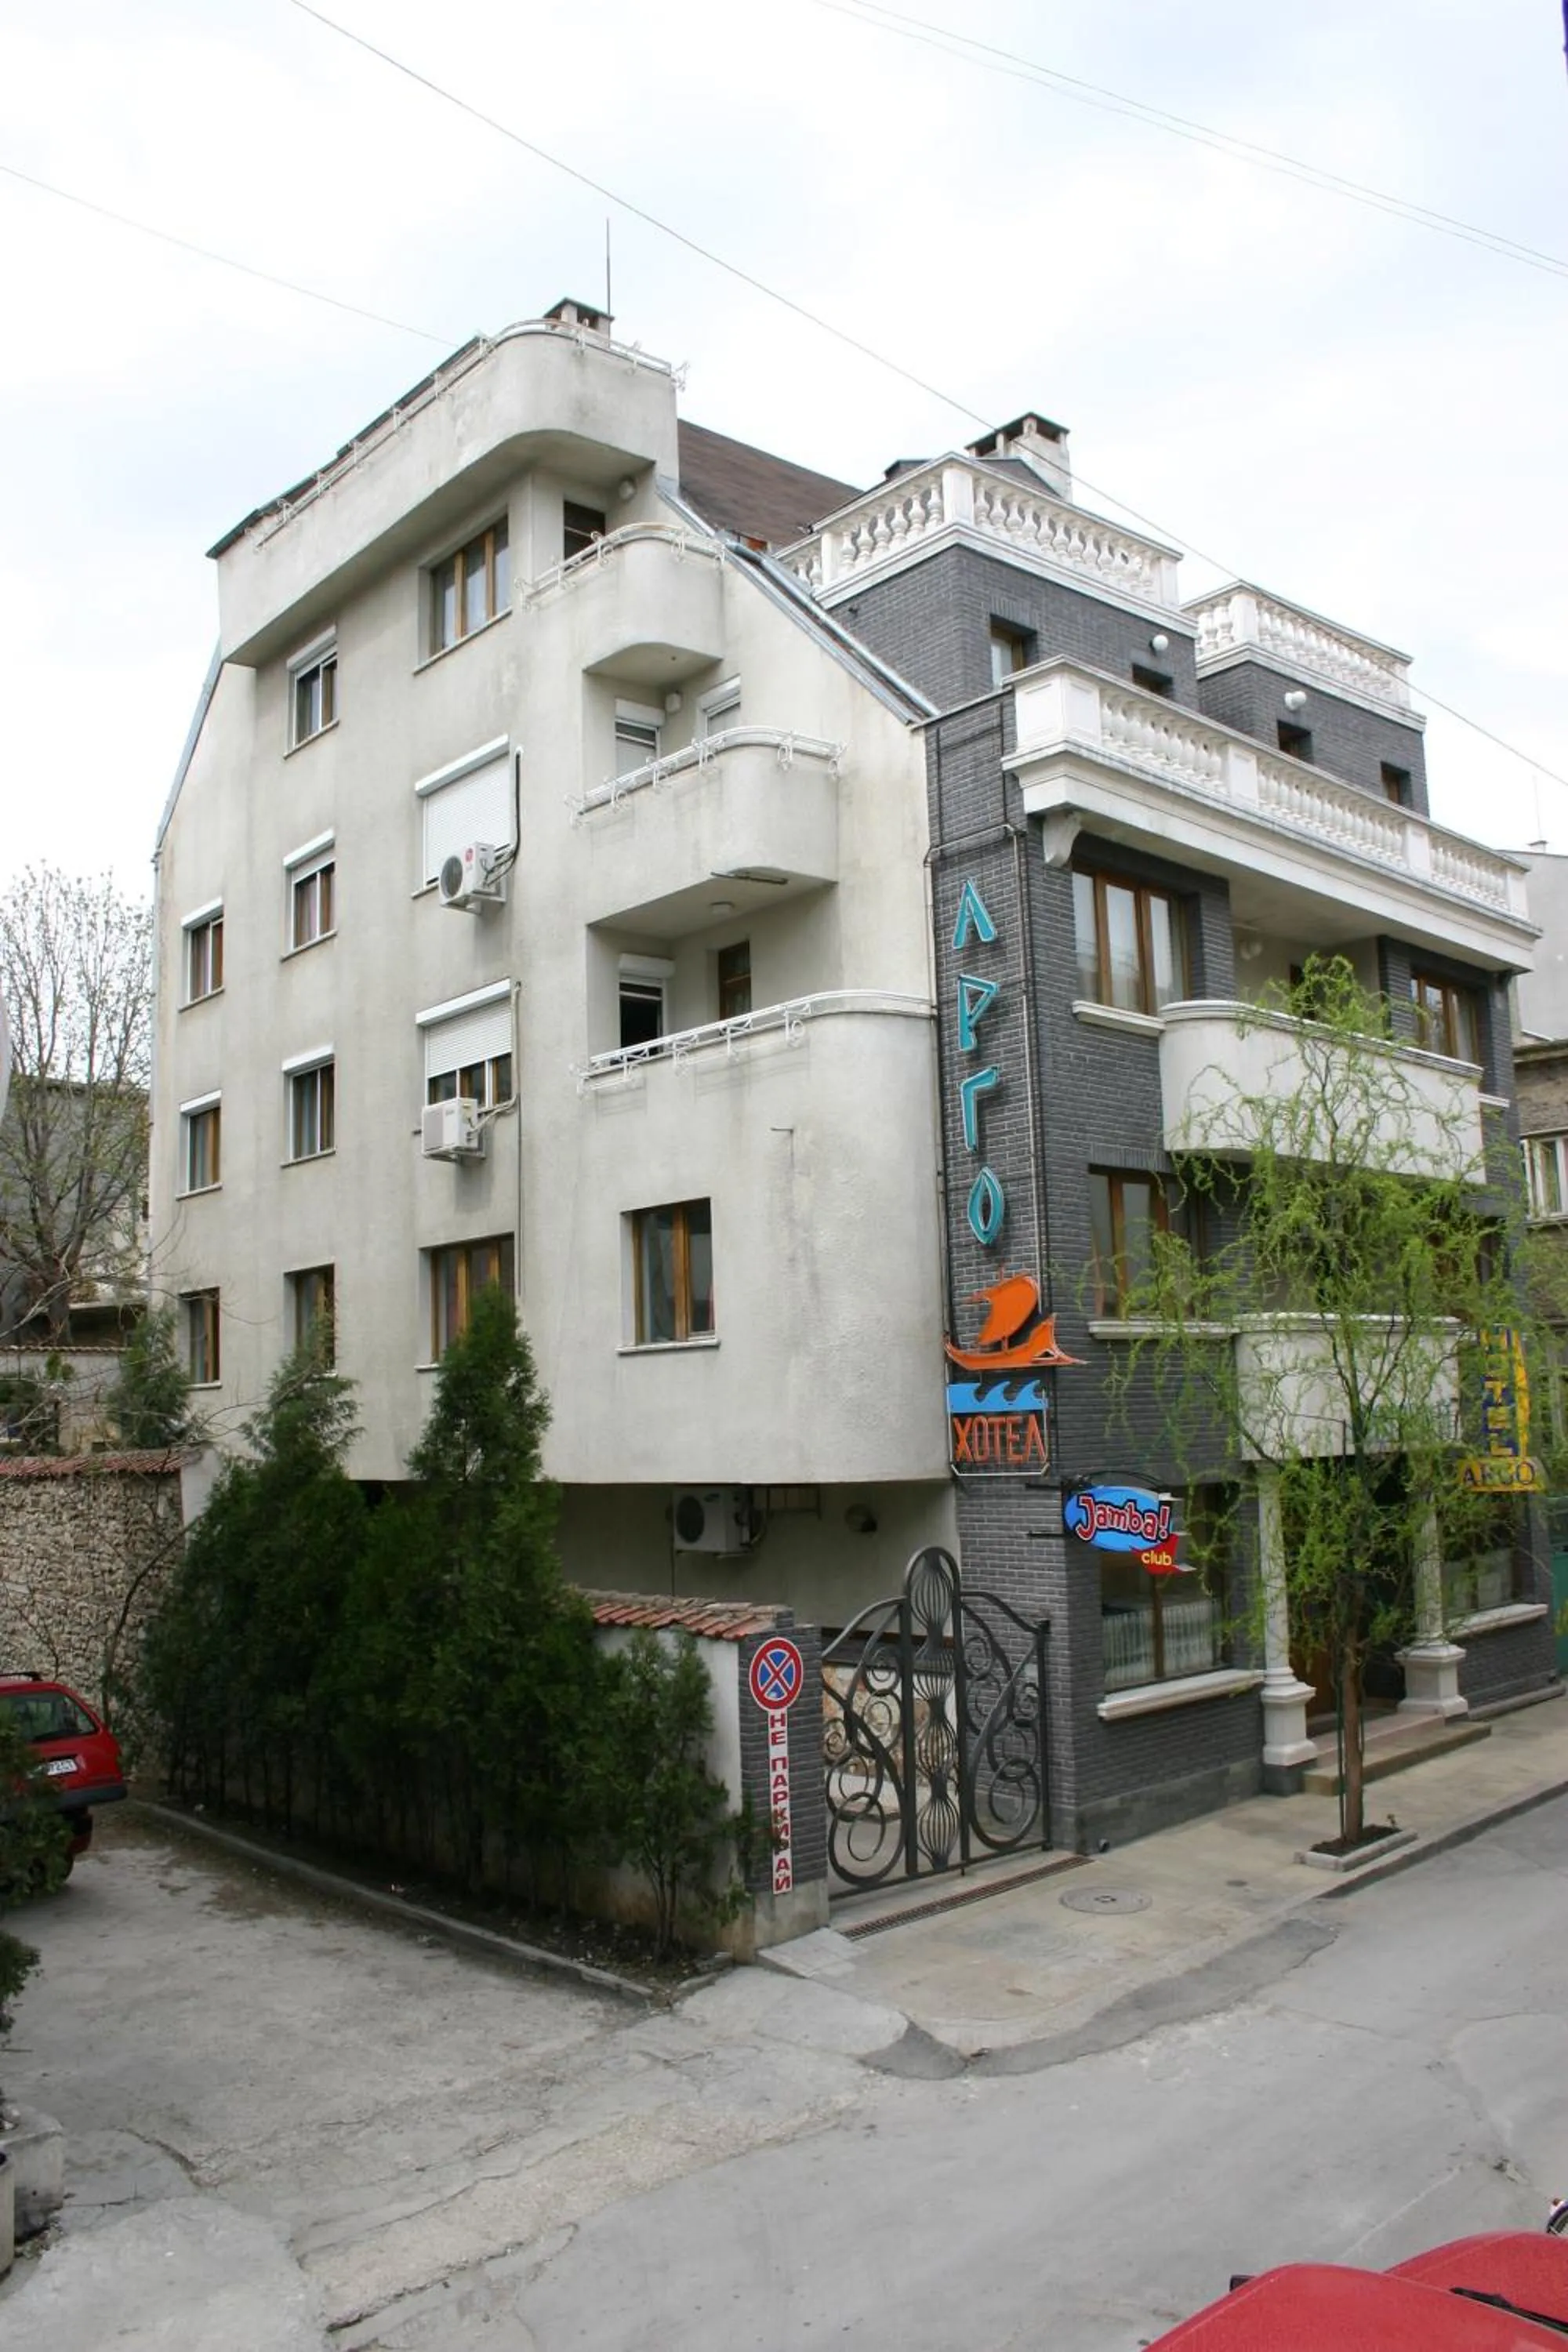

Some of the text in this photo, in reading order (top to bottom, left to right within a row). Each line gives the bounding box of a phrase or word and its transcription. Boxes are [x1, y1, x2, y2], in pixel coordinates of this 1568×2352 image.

[953, 1414, 1047, 1465] ХОТЕЛ
[1075, 1494, 1171, 1541] Jamba!
[1142, 1551, 1172, 1566] club
[770, 1713, 786, 1745] НЕ
